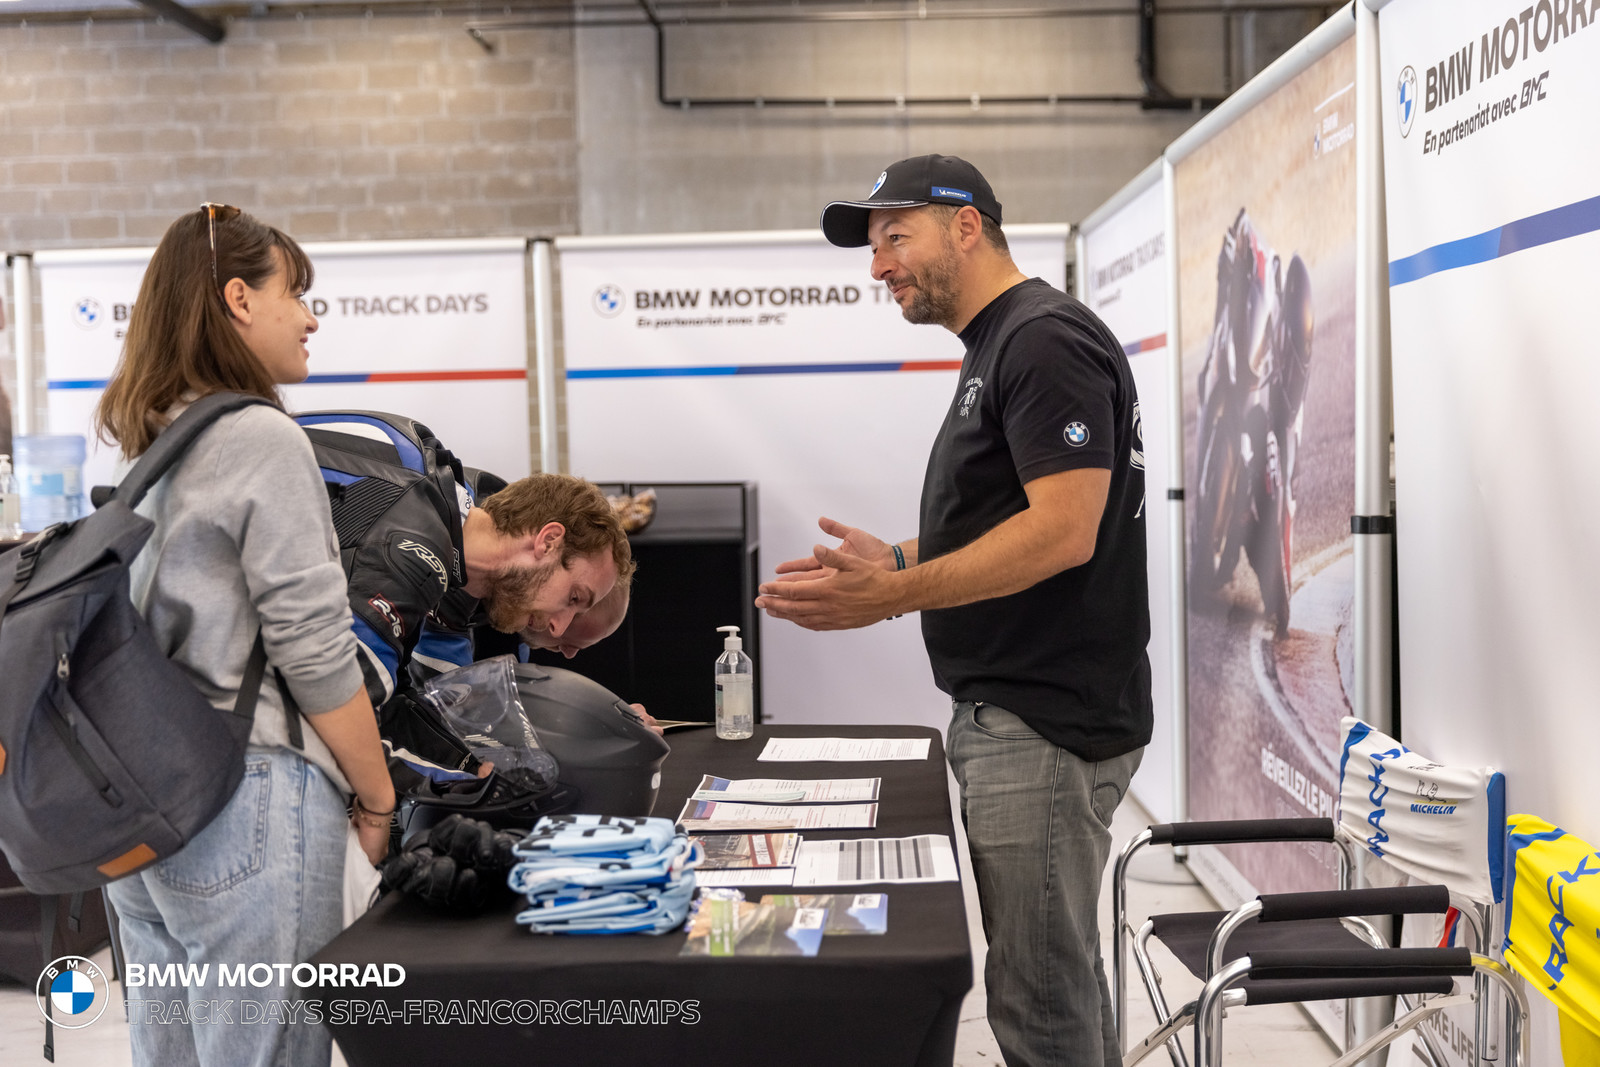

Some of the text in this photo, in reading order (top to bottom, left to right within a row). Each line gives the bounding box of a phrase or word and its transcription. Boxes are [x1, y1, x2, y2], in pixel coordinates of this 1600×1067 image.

[1425, 41, 1474, 113] BMW
[1423, 70, 1549, 155] En partenariat avec BMC
[338, 295, 419, 316] TRACK
[426, 293, 489, 314] DAYS
[635, 289, 700, 310] BMW
[709, 286, 861, 307] MOTORRAD
[398, 539, 448, 592] RST
[372, 599, 403, 638] R-16
[1306, 780, 1319, 816] LE
[1410, 803, 1457, 815] MICHELIN
[1543, 854, 1600, 991] RACK
